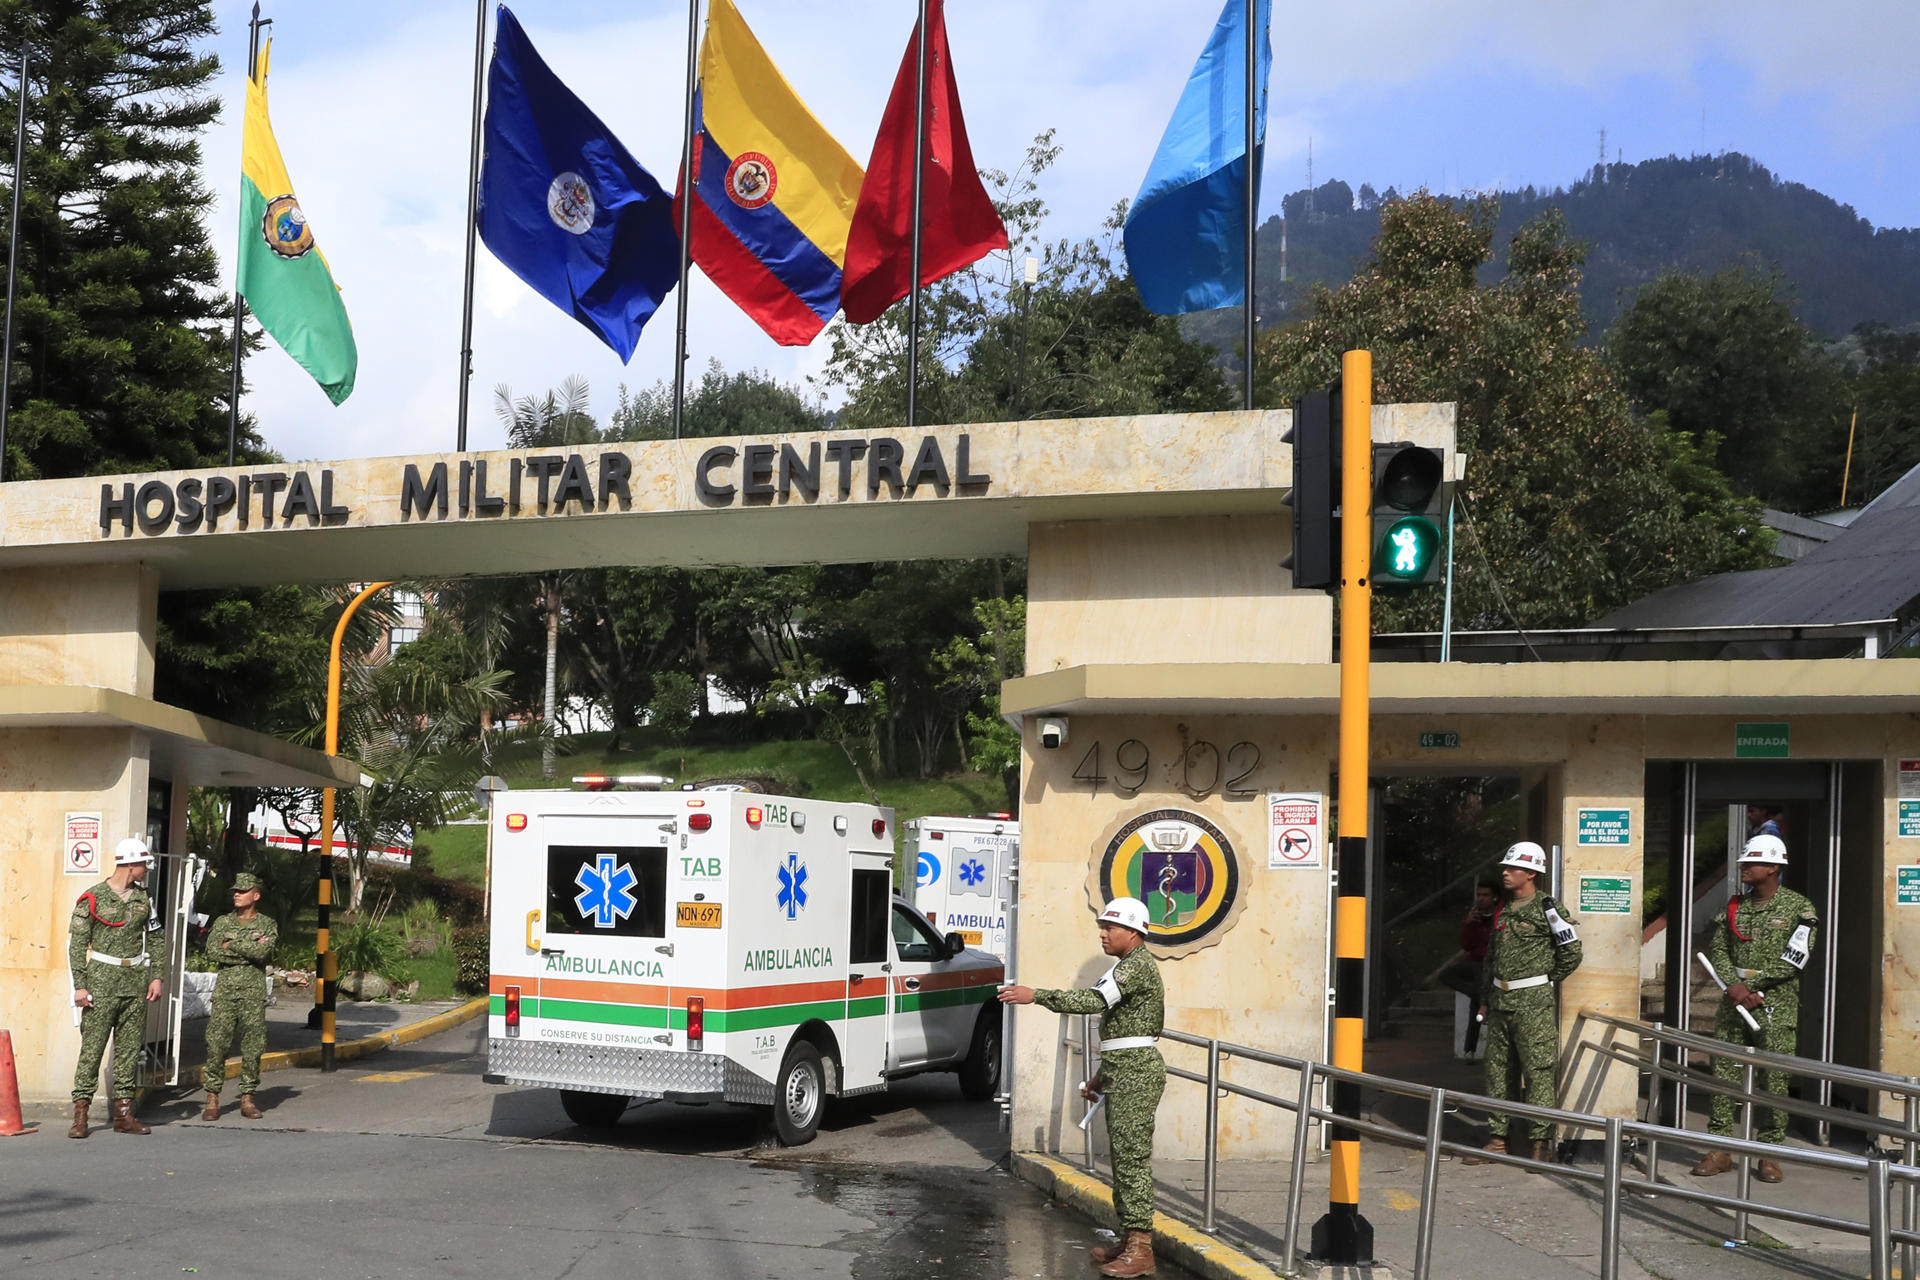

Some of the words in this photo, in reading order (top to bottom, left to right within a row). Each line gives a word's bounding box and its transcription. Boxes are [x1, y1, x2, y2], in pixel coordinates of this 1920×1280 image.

[99, 469, 350, 536] HOSPITAL
[400, 452, 633, 521] MILITAR
[696, 434, 993, 506] CENTRAL
[1737, 737, 1788, 746] ENTRADA
[765, 804, 788, 823] TAB
[1115, 811, 1173, 845] HOSPITAL
[1181, 811, 1226, 844] MILITAR
[973, 836, 985, 845] PBX
[680, 857, 722, 876] TAB
[947, 914, 1005, 929] AMBULA
[545, 954, 664, 978] AMBULANCIA
[744, 947, 833, 972] AMBULANCIA
[540, 1028, 588, 1040] CONSERVE
[590, 1032, 602, 1041] SU
[605, 1034, 653, 1045] DISTANCIA
